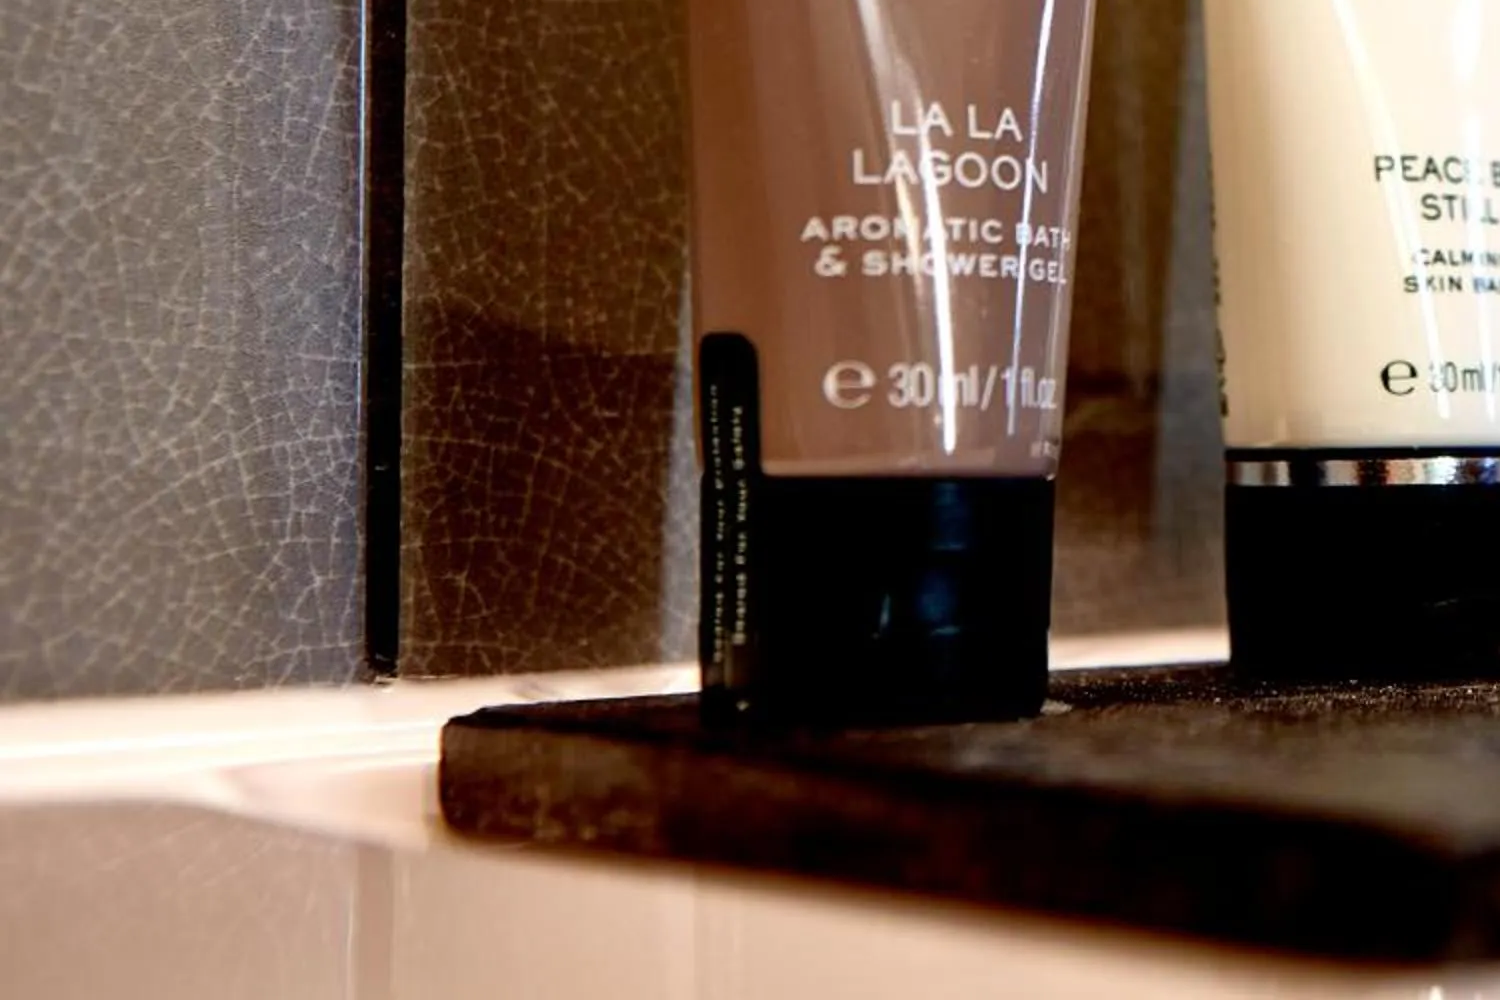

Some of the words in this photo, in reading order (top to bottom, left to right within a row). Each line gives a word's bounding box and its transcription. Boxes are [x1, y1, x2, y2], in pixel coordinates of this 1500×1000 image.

[891, 99, 954, 138] LA
[967, 103, 1024, 143] LA
[852, 148, 1049, 194] LAGOON
[813, 245, 848, 277] &
[1028, 257, 1067, 285] GEL
[1402, 274, 1463, 294] SKIN
